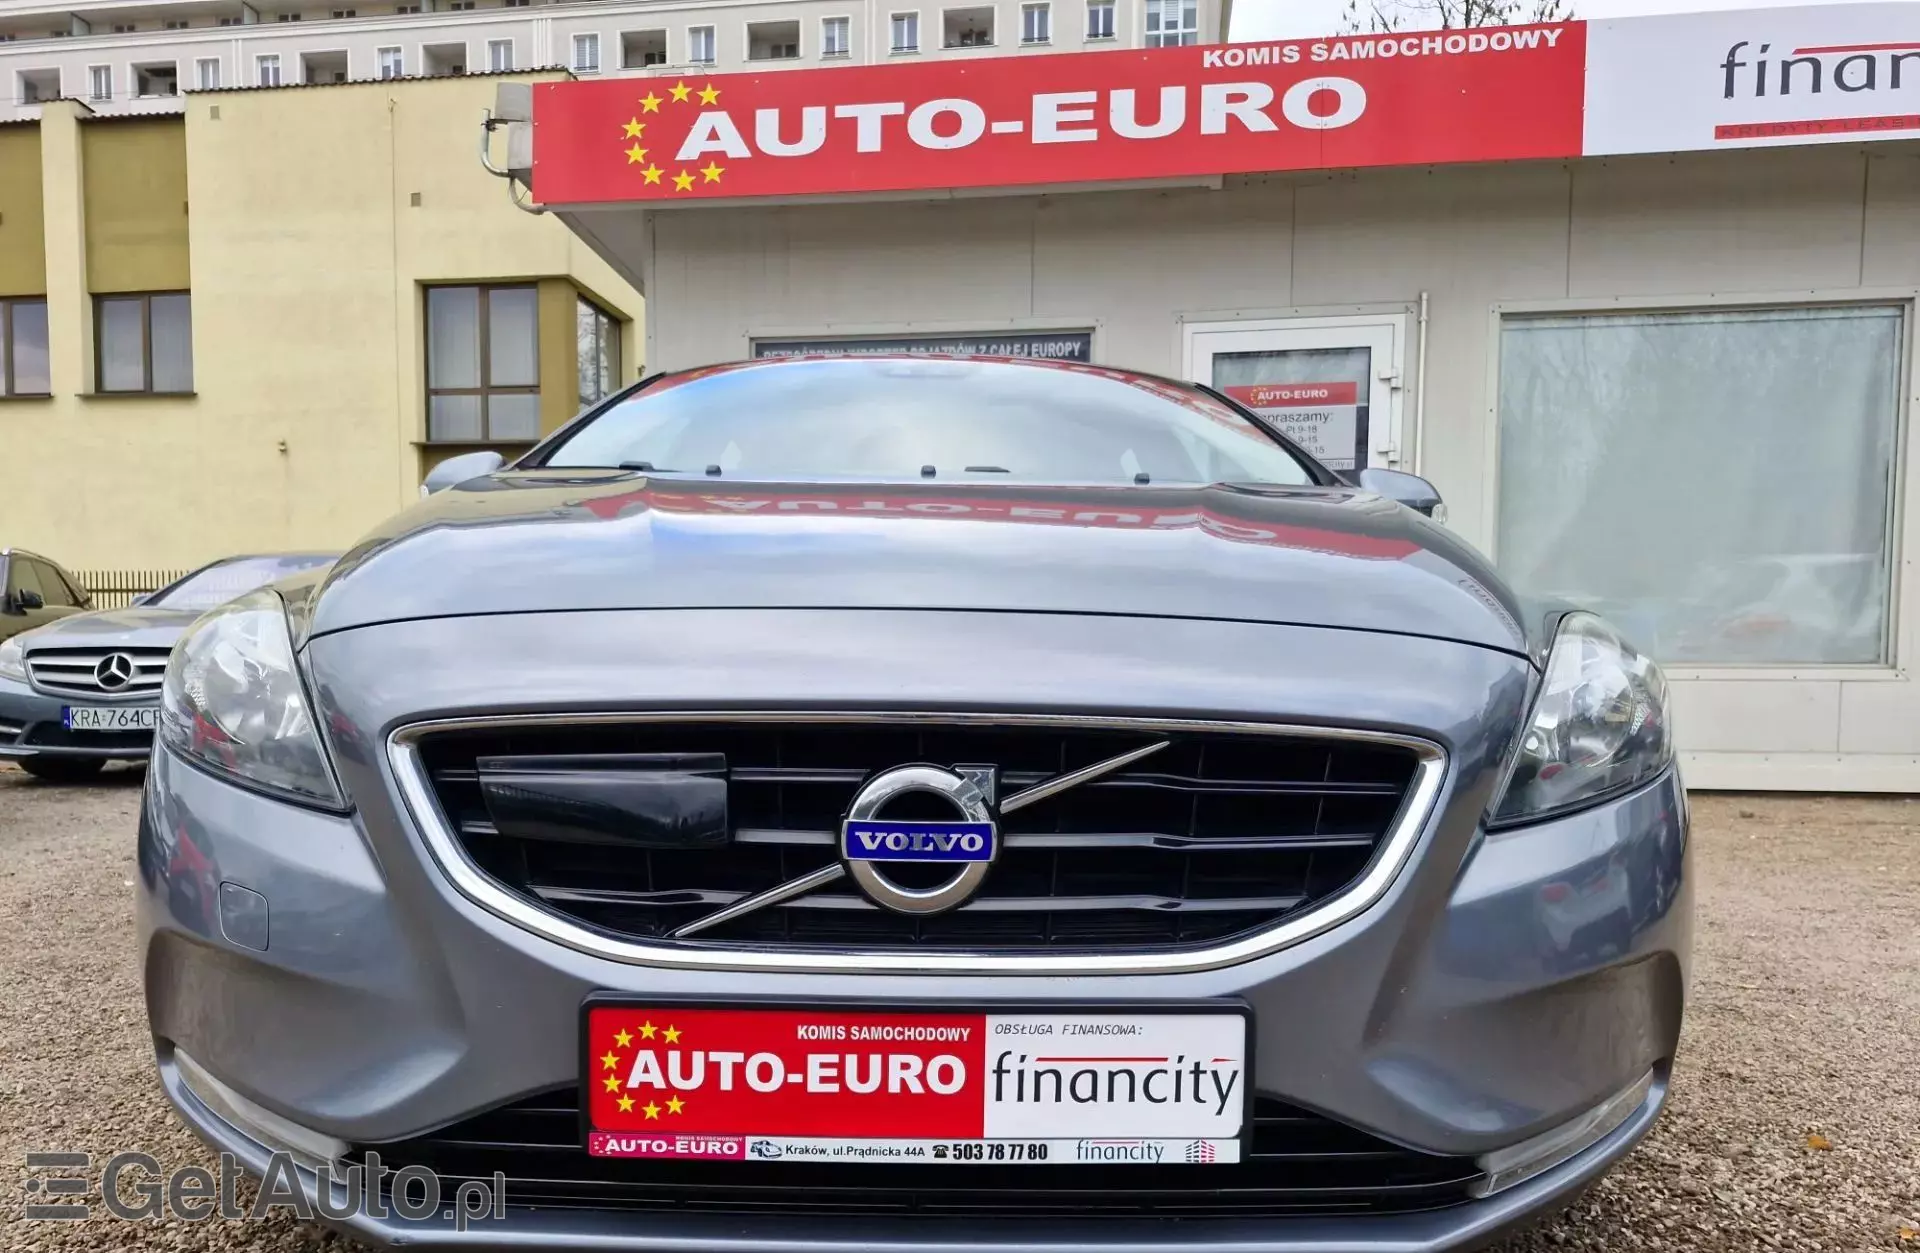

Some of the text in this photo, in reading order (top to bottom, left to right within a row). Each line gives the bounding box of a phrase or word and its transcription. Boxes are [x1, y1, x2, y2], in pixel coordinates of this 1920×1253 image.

[1203, 29, 1565, 69] KOMIS SAMOCHODOWY
[674, 77, 1367, 161] AUTO-EURO
[1032, 342, 1081, 358] EUROPY
[1257, 388, 1329, 400] AUTO-EURO
[71, 709, 101, 727] KRA
[855, 831, 984, 852] VOLVO
[797, 1025, 970, 1043] KOMIS SAMOCHODOWY
[994, 1023, 1144, 1036] OBSŁUGA FINANSOWA:
[626, 1049, 966, 1096] AUTO-EURO
[992, 1050, 1239, 1116] financity
[605, 1138, 739, 1155] AUTO-EURO
[785, 1145, 830, 1157] Kraków,
[904, 1147, 925, 1157] 44A
[953, 1144, 983, 1160] 503
[987, 1144, 1005, 1160] 78
[1008, 1144, 1025, 1160] 77
[1028, 1144, 1048, 1160] 80
[1077, 1138, 1165, 1164] financity
